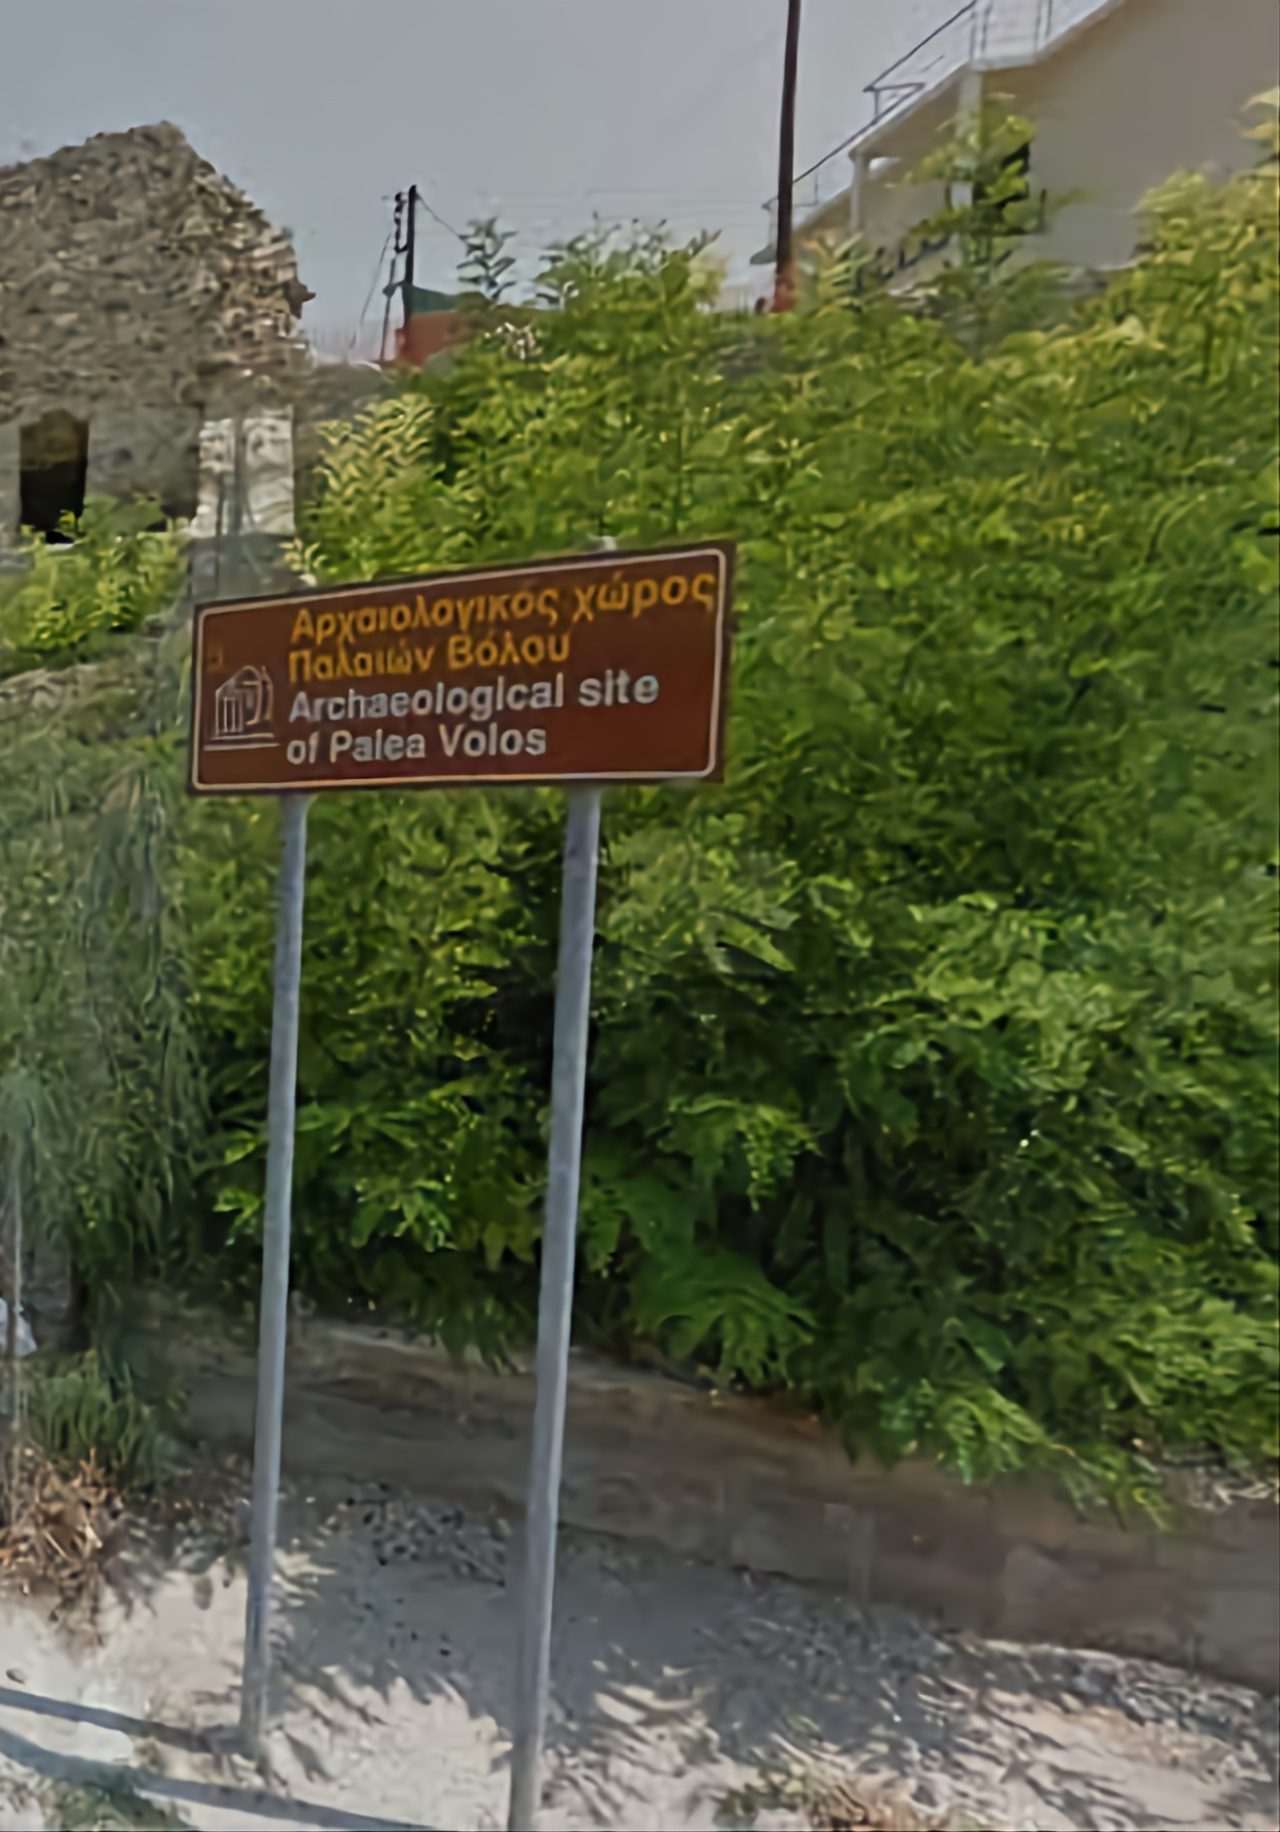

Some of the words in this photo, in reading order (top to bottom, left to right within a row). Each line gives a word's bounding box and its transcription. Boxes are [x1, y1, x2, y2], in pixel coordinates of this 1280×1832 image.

[571, 571, 717, 623] χώρος
[288, 641, 436, 684] Παλαιών
[448, 631, 571, 670] Βόλου
[288, 673, 565, 725] Archaeological
[579, 669, 660, 709] site
[286, 731, 318, 766] of
[329, 729, 426, 764] Palea
[439, 723, 548, 758] Volos
